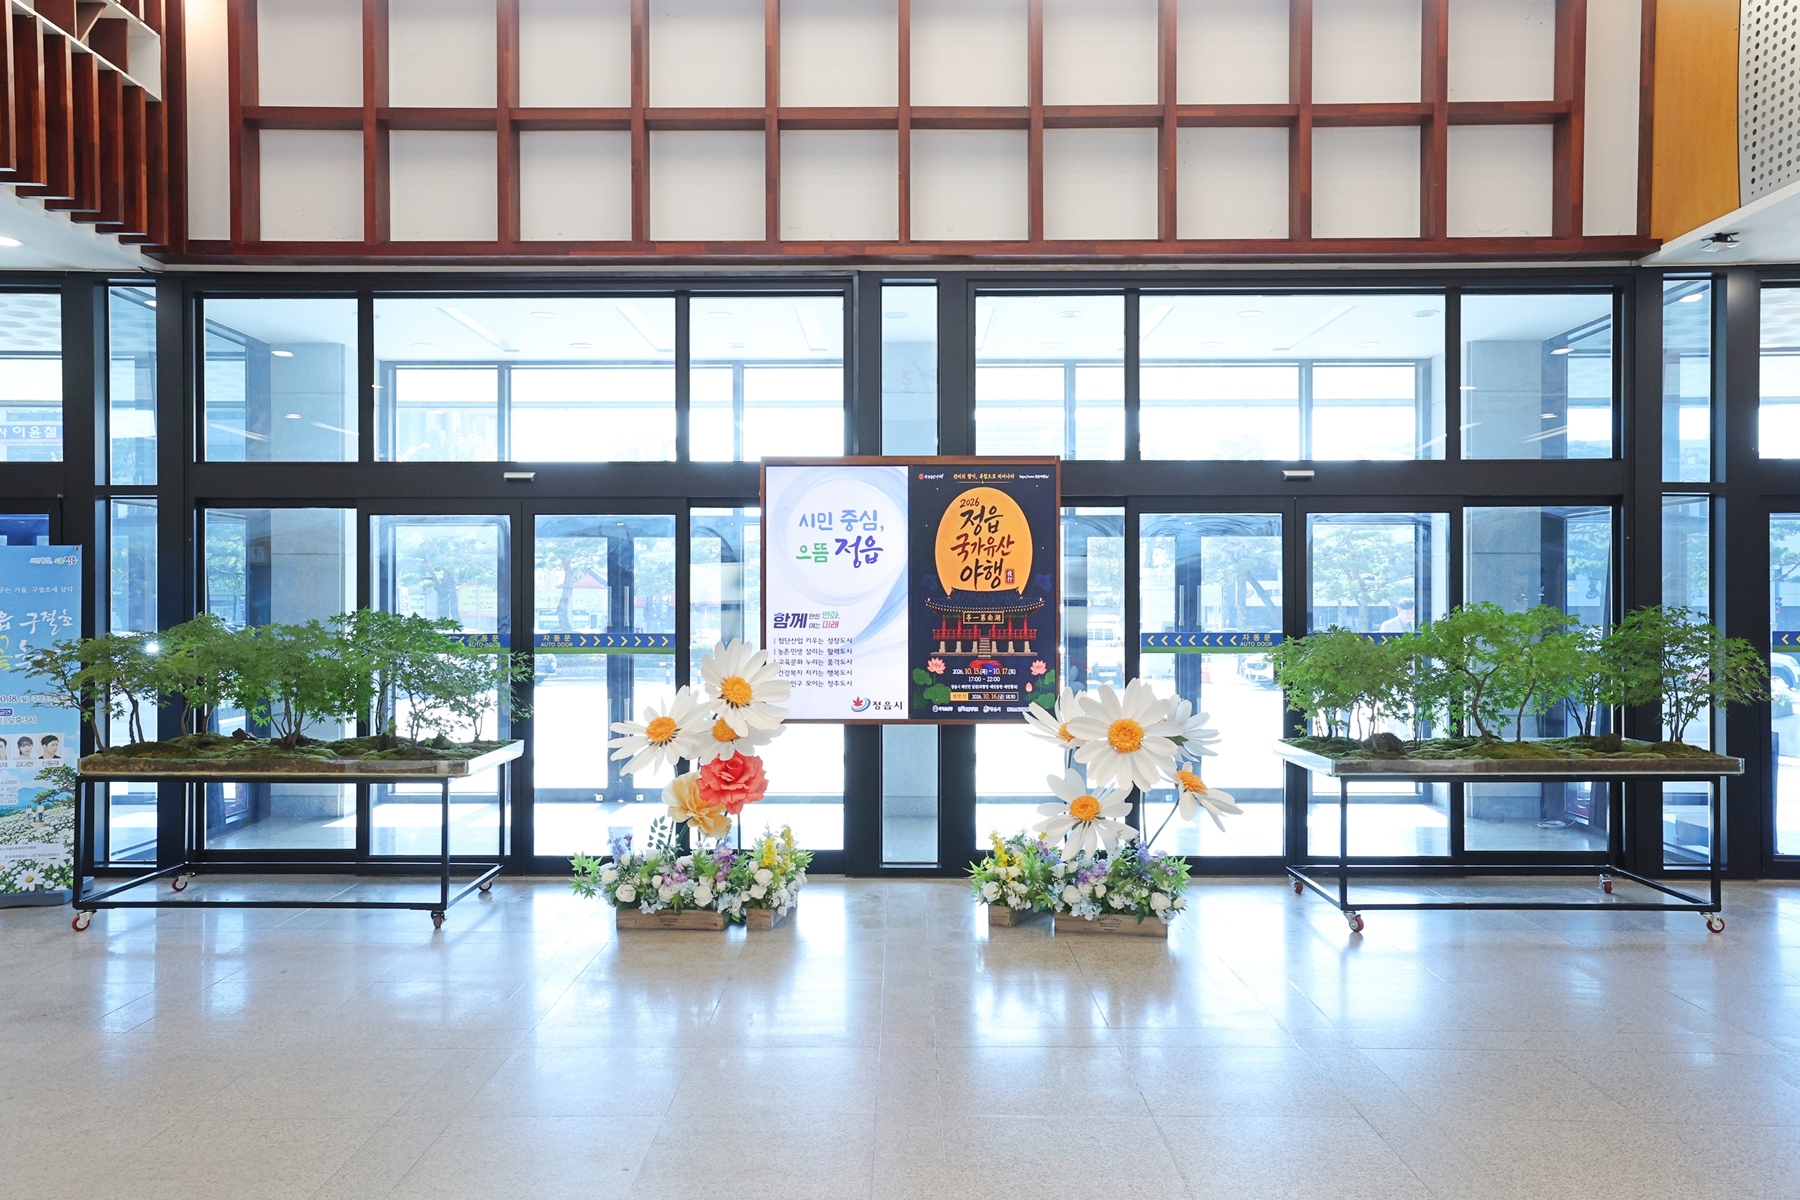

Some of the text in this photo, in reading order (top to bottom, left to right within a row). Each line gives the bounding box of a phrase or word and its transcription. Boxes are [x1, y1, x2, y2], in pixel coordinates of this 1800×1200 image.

[12, 426, 57, 439] 이윤철
[959, 497, 979, 508] 2026
[799, 509, 884, 532] 시민 중심,
[960, 505, 1003, 536] 정읍
[796, 535, 884, 568] 으뜸 정읍
[950, 533, 1015, 563] 국가유산
[960, 558, 1004, 590] 야행
[19, 608, 73, 636] 구절초
[773, 612, 808, 629] 함께
[822, 621, 839, 629] 미래
[806, 637, 824, 645] 키우는
[827, 637, 852, 645] 성장도시
[806, 648, 824, 656] 살리는
[872, 701, 902, 710] 정읍시
